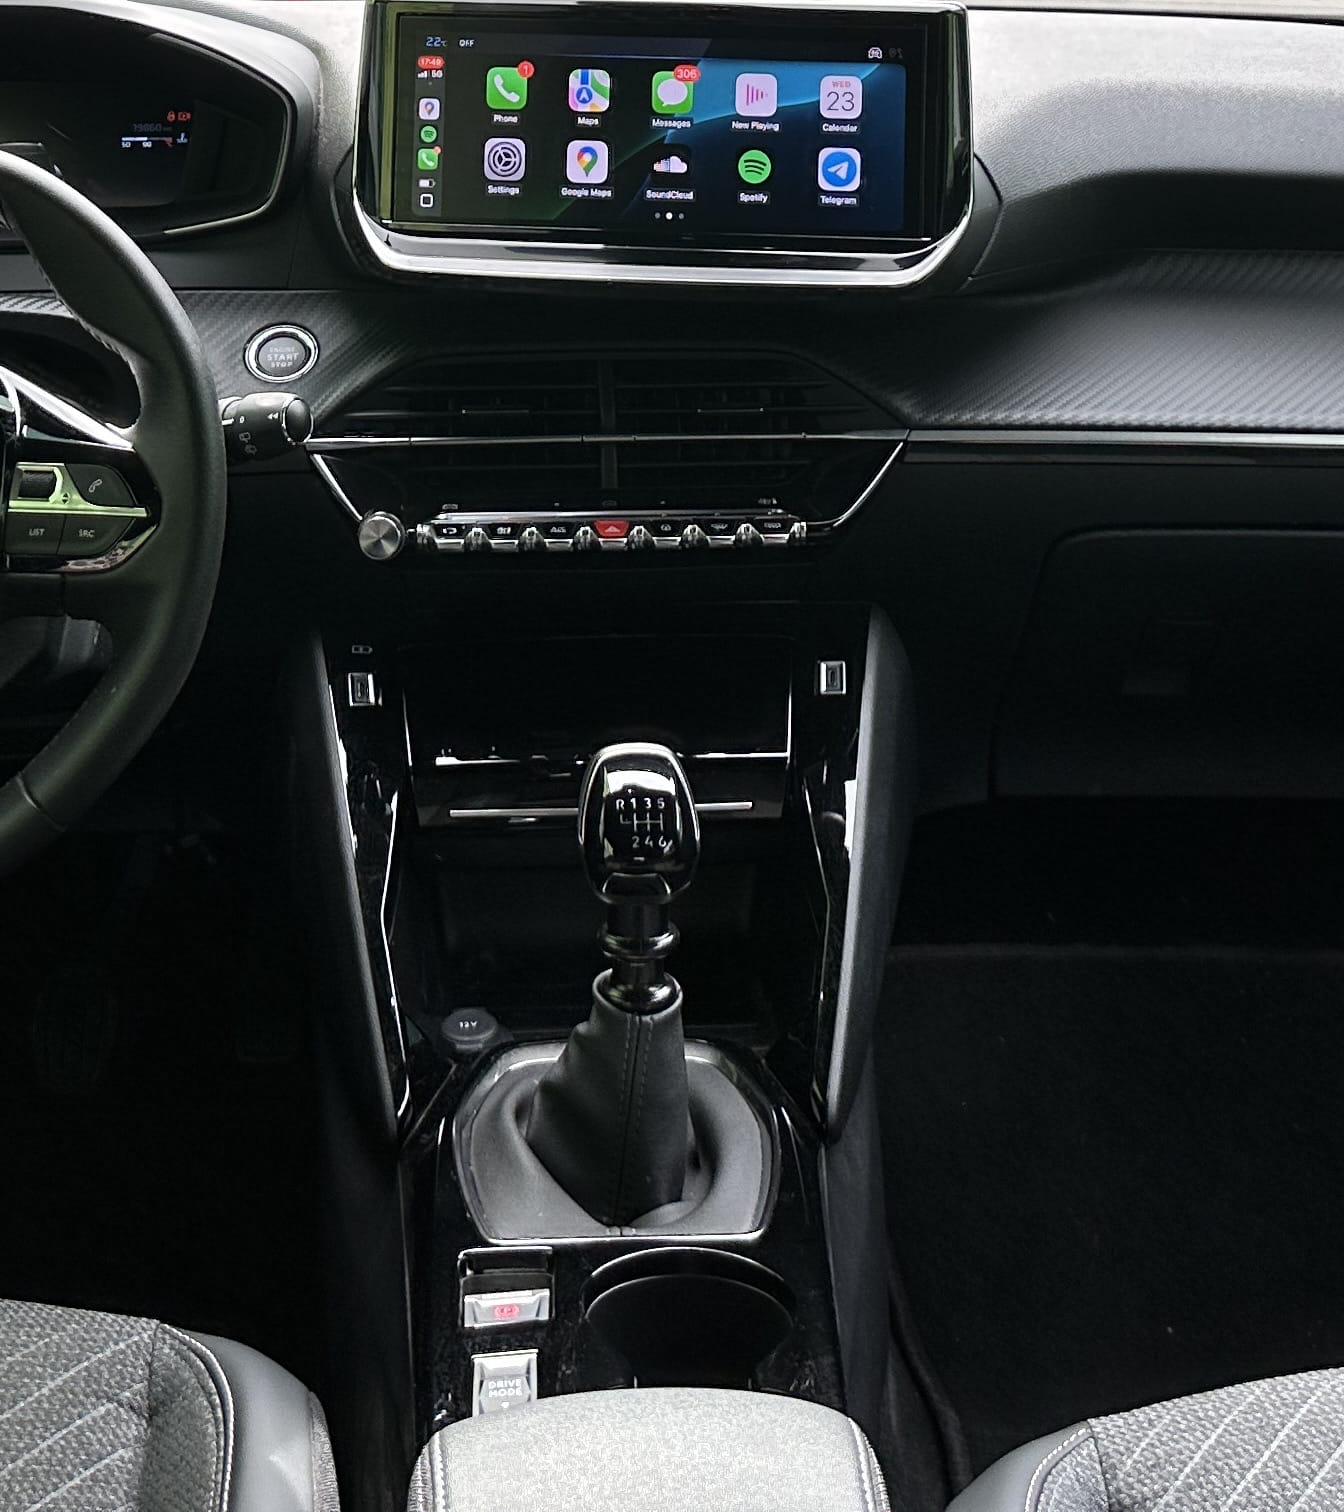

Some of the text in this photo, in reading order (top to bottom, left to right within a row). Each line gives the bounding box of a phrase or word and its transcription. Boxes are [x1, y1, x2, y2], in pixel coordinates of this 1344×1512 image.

[458, 38, 475, 48] OFF
[675, 68, 698, 80] 306
[831, 80, 852, 89] WED
[826, 91, 855, 113] 23
[493, 114, 519, 124] Phone
[577, 116, 600, 127] Maps
[651, 118, 692, 130] Messages
[732, 120, 781, 133] Now Playing
[822, 122, 858, 134] Calendar
[487, 184, 521, 196] Settings
[561, 187, 613, 199] Google Maps
[646, 190, 694, 201] SoundCloud
[739, 192, 770, 204] Spotify
[820, 195, 857, 207] Telegram
[267, 352, 299, 361] START
[28, 528, 46, 537] LIST
[616, 797, 666, 811] R 1 3 5
[631, 835, 667, 848] 2 4 6
[488, 1378, 522, 1390] DRIVE
[488, 1387, 523, 1398] MODE
